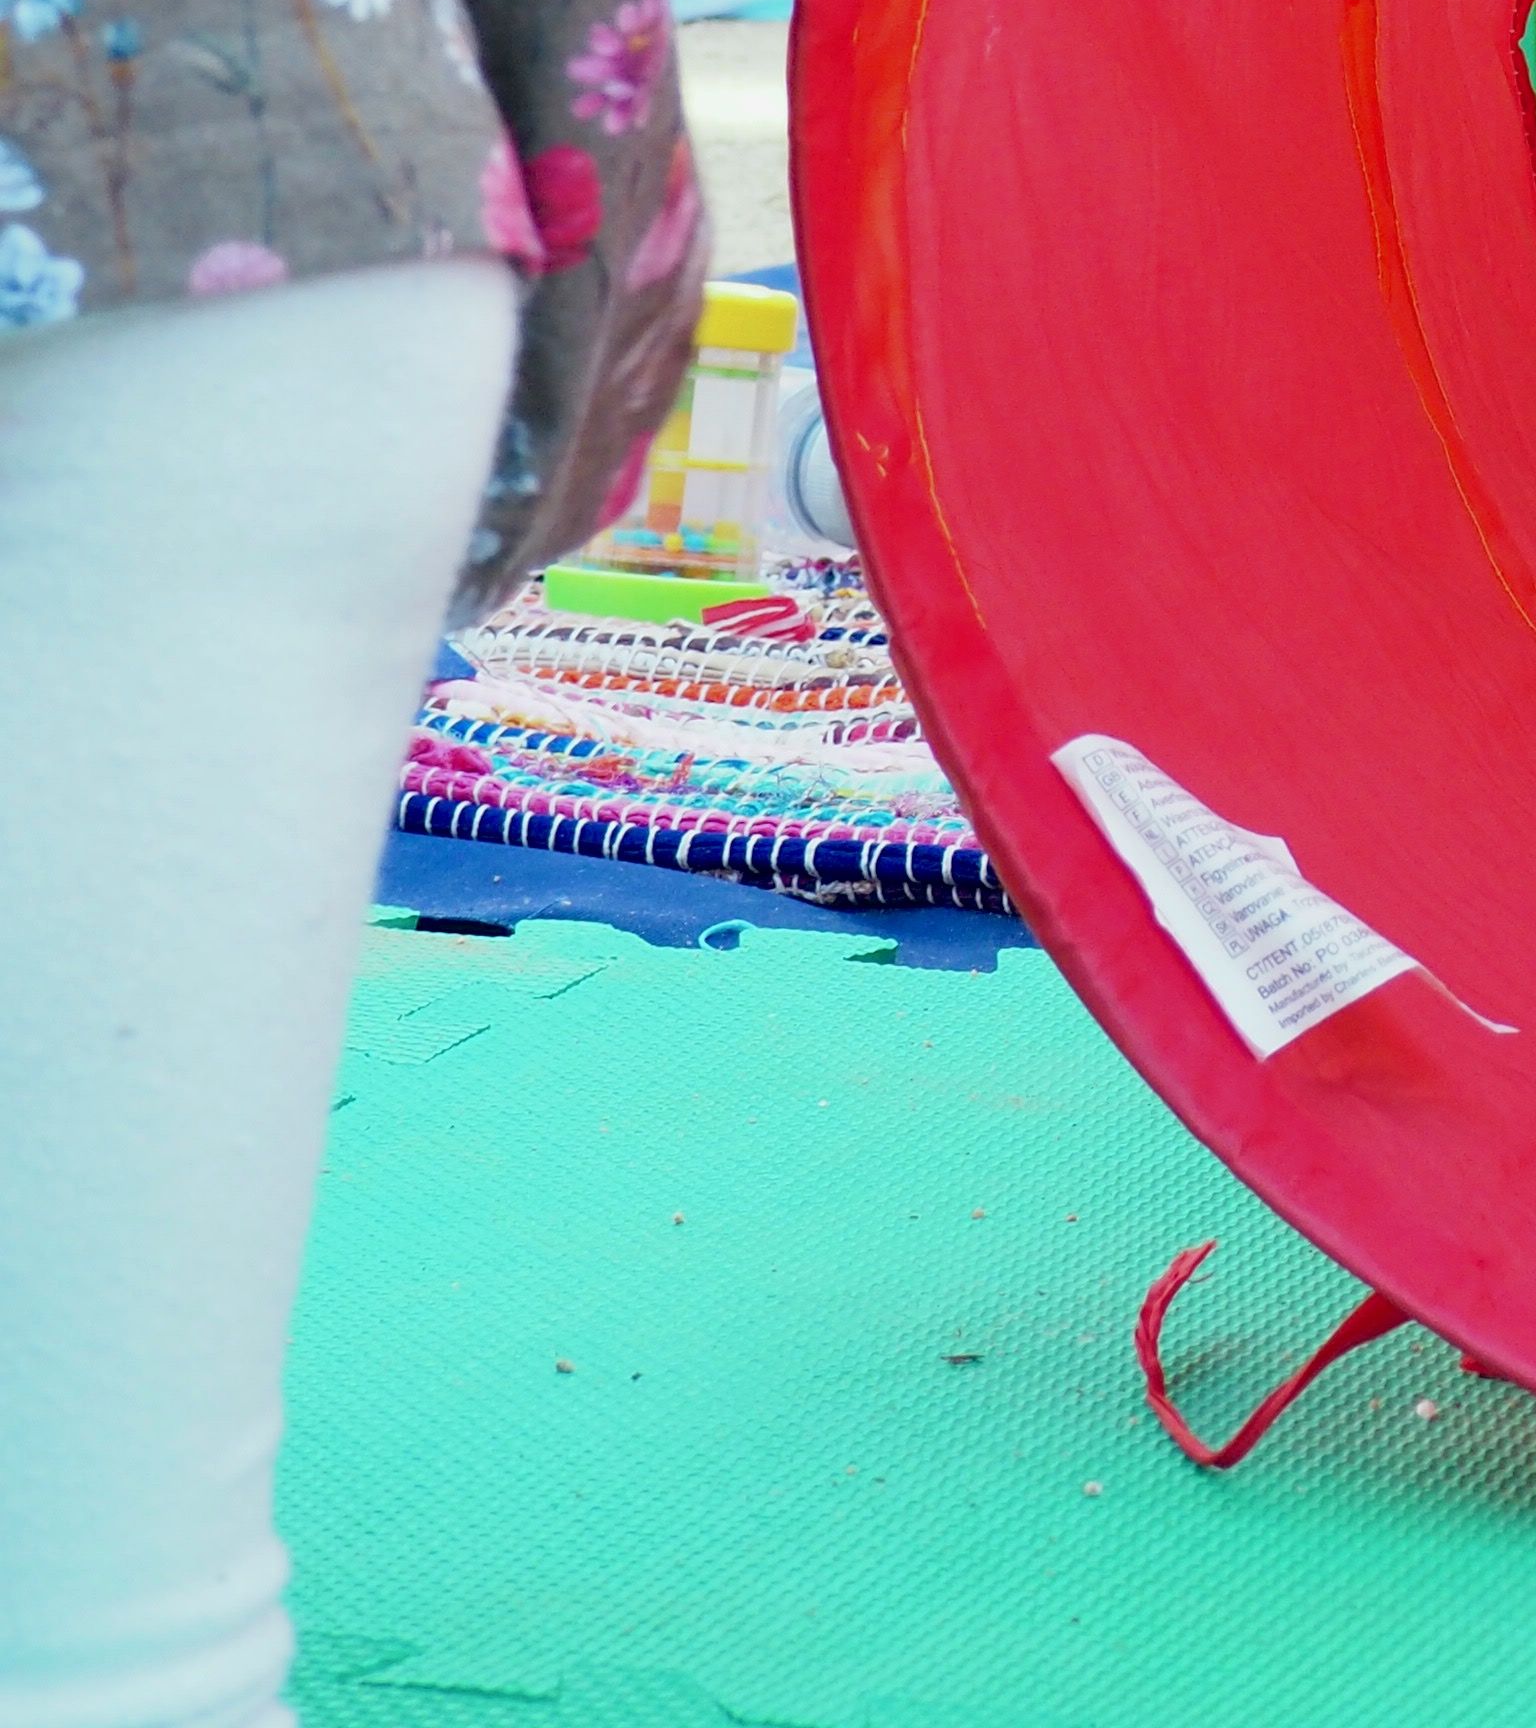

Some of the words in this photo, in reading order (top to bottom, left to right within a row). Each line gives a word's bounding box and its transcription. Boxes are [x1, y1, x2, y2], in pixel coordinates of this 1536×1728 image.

[1246, 909, 1291, 944] UWAGA
[1258, 969, 1294, 1000] Batch
[1268, 970, 1333, 1015] Manufactured
[1278, 995, 1322, 1029] Imported
